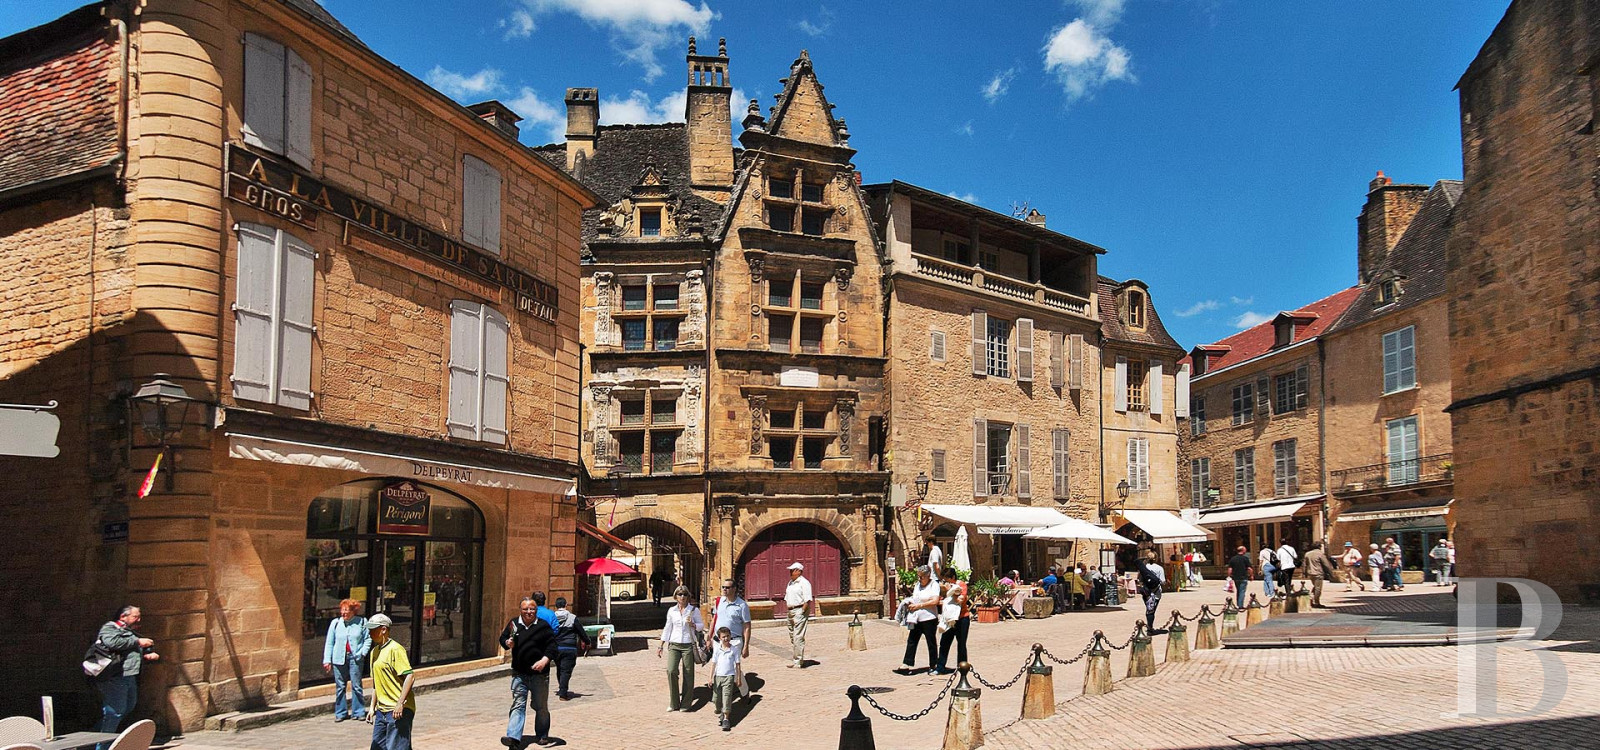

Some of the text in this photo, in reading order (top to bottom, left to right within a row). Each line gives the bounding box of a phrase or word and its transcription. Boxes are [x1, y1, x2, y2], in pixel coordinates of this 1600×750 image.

[246, 185, 302, 221] GROS
[246, 158, 270, 185] A
[289, 173, 334, 211] LA
[350, 199, 430, 250] VILLE
[478, 256, 550, 301] SARLAT
[521, 296, 555, 321] DETAIL
[413, 463, 472, 483] DELPEYRAT
[387, 488, 425, 500] DELPEYRAT
[385, 505, 426, 522] Périgord
